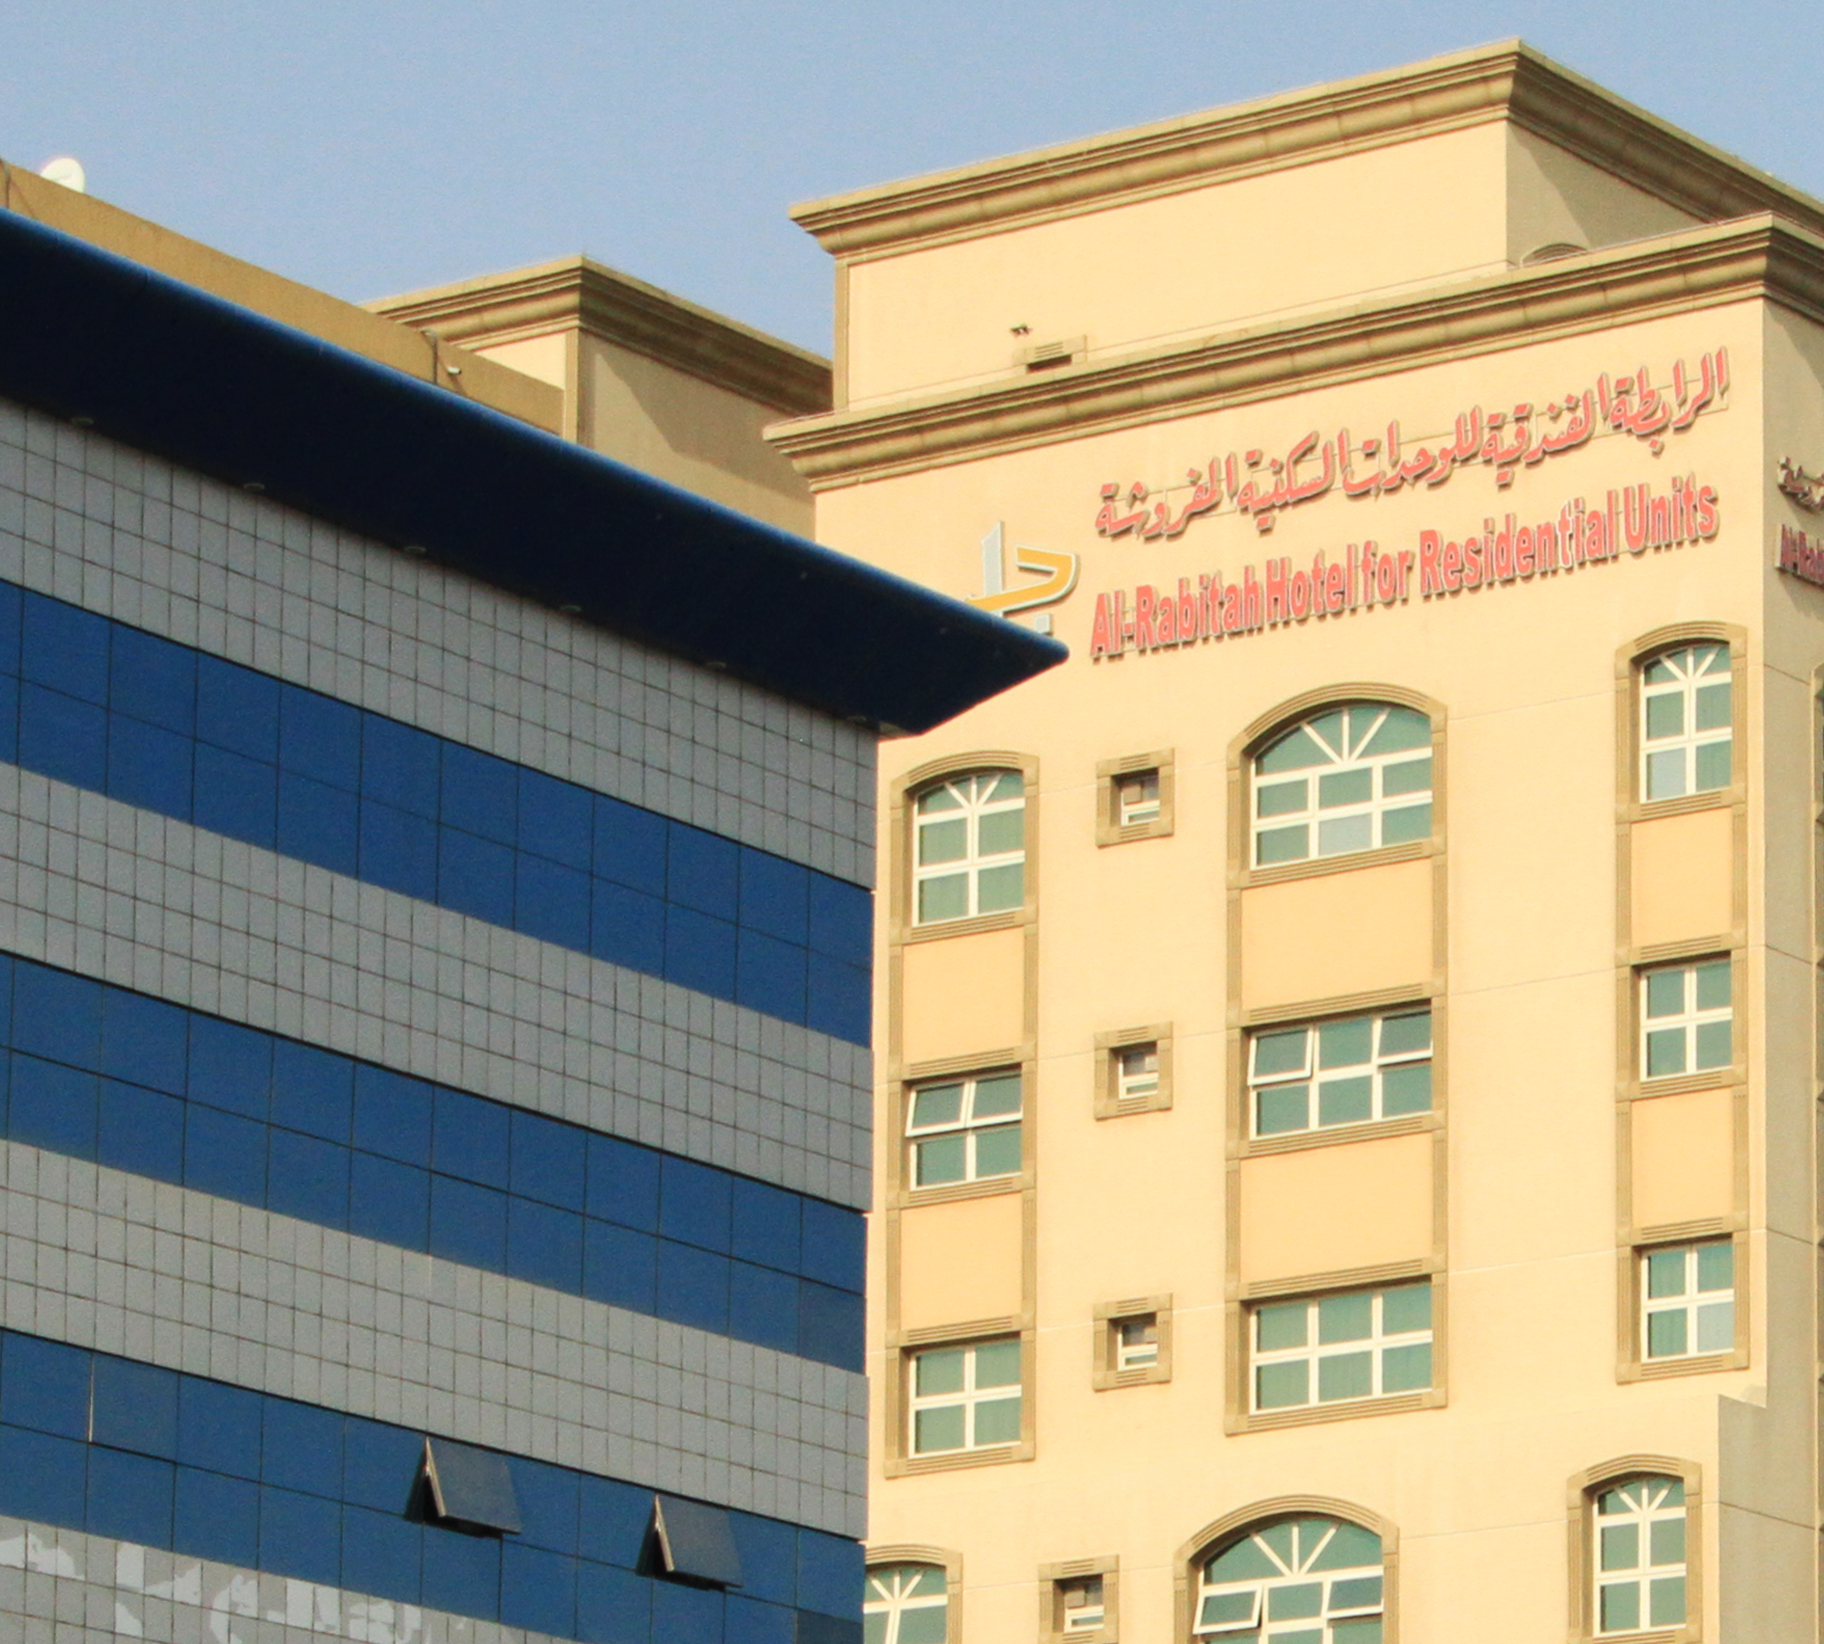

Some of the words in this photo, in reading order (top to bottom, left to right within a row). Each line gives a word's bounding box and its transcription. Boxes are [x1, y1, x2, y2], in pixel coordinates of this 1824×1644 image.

[1343, 406, 1481, 500] للوحدات
[1479, 371, 1609, 489] الفندقية
[1609, 346, 1730, 457] الرابطة
[1095, 450, 1239, 545] المفروشة
[1237, 427, 1349, 538] السكنية
[1090, 565, 1266, 662] Al-Rabitah
[1265, 543, 1359, 628] Hotel
[1360, 540, 1415, 610] for
[1420, 490, 1625, 602] Residential
[1623, 473, 1721, 562] Units
